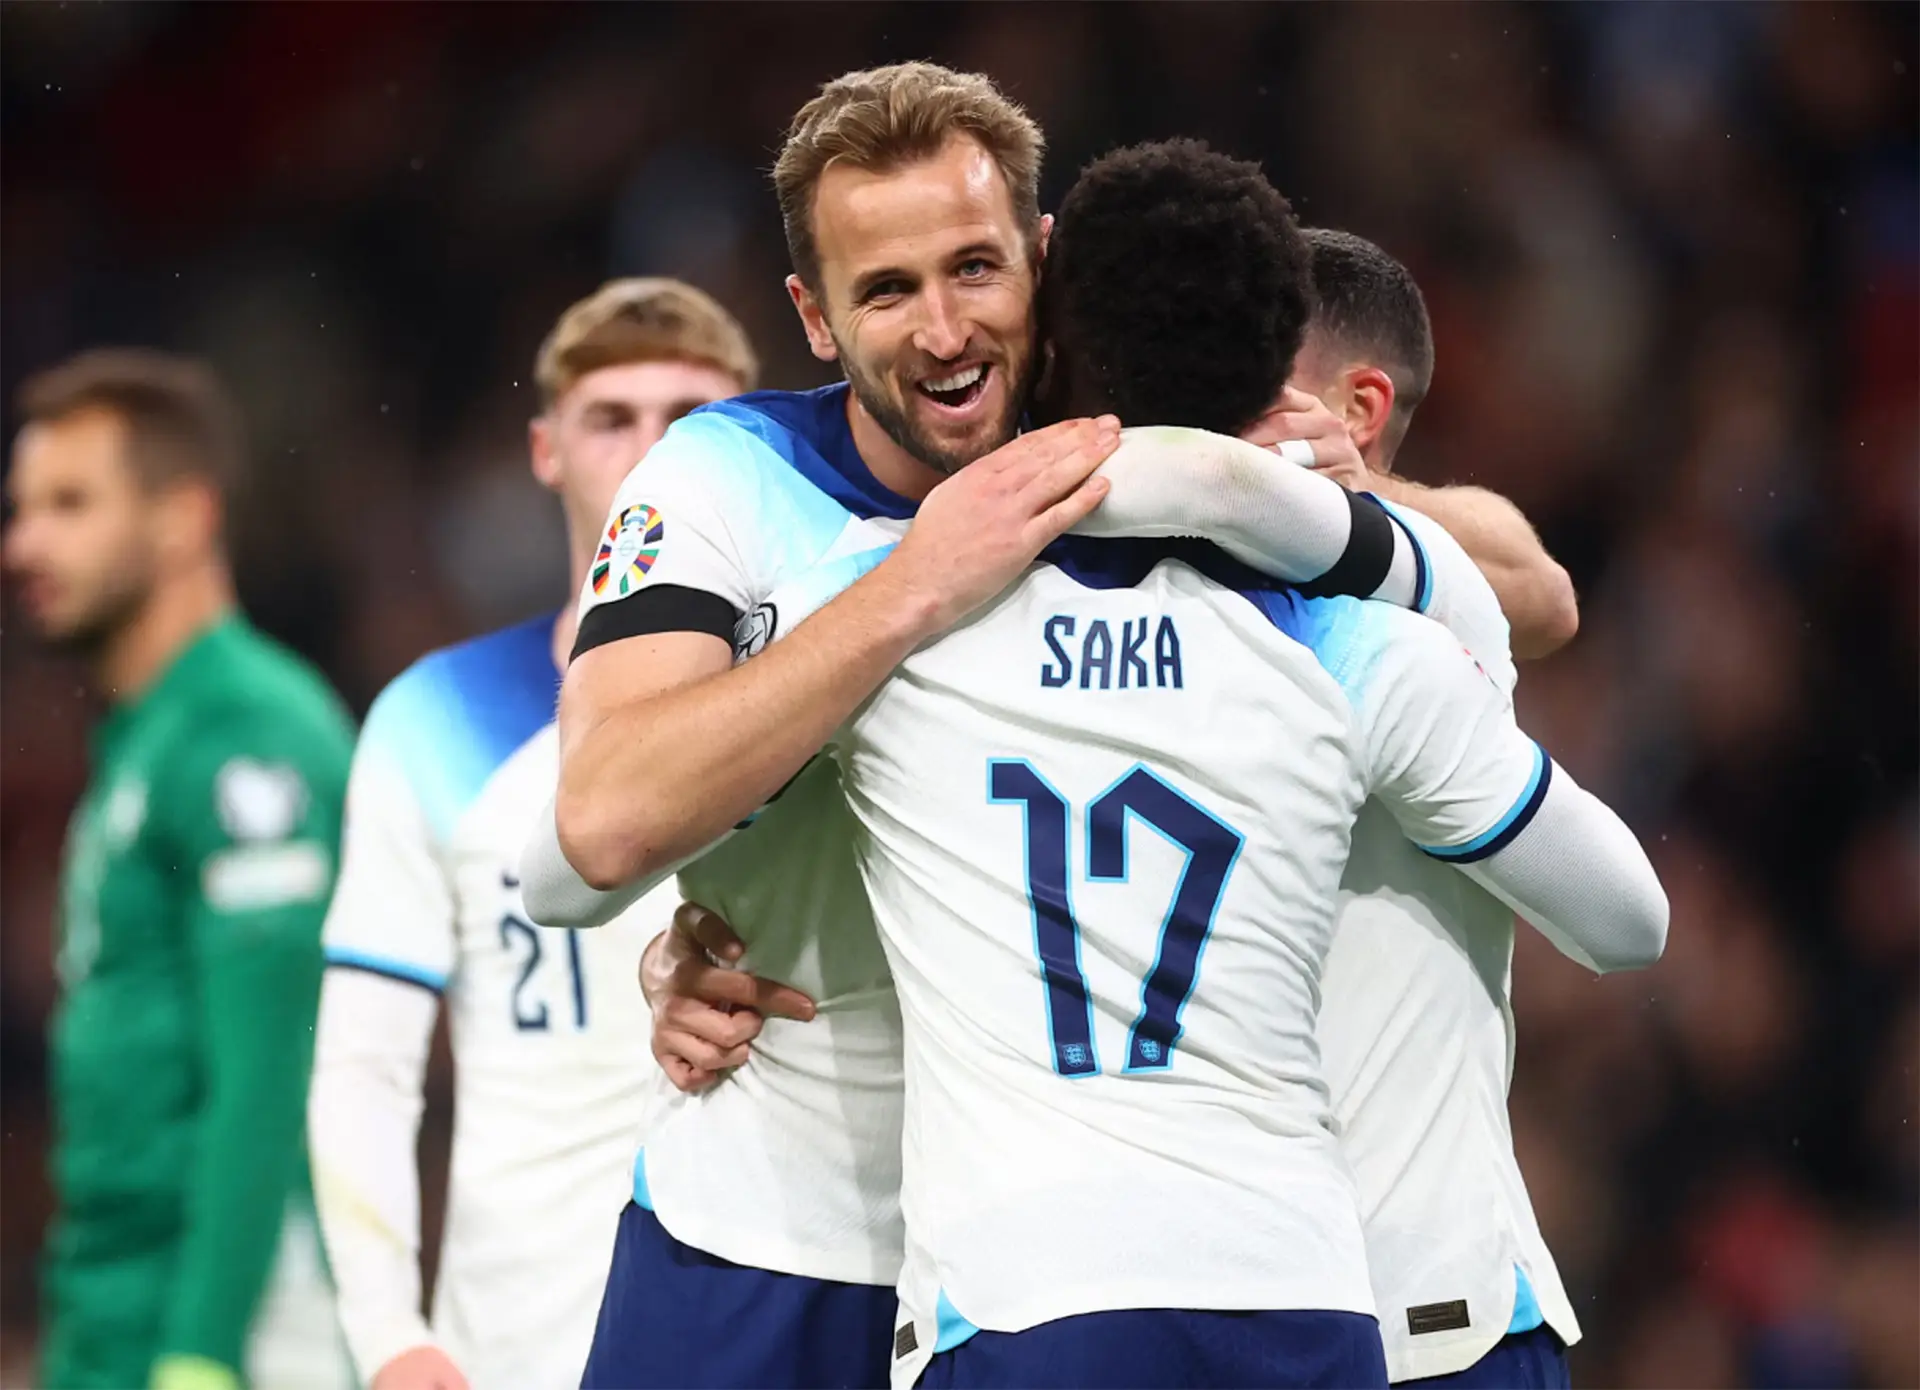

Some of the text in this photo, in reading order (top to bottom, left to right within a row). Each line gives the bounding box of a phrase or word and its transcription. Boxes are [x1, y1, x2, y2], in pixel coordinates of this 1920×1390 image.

[1041, 615, 1184, 689] SAKA
[500, 913, 587, 1031] 21
[986, 757, 1247, 1079] 17
